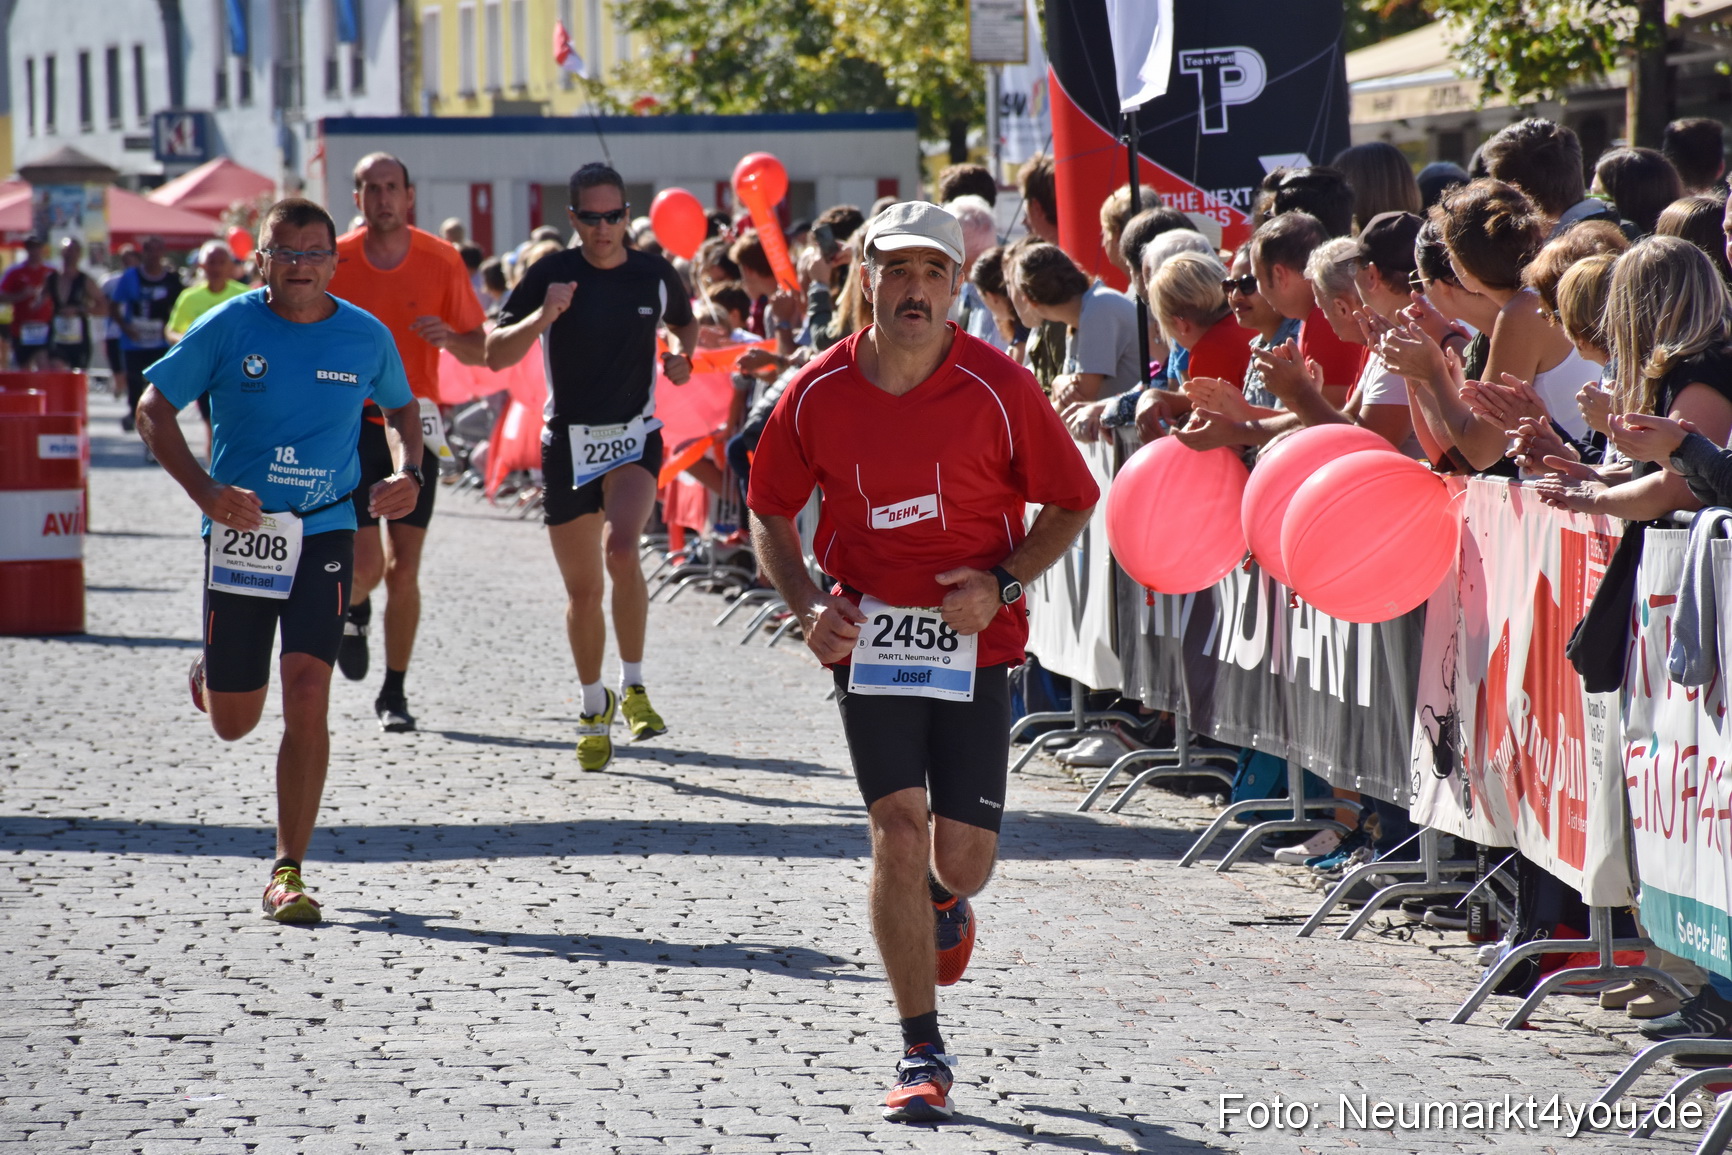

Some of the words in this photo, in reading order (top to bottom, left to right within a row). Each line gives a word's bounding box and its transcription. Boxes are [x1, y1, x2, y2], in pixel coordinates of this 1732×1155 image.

[1161, 191, 1199, 212] THE
[1203, 187, 1253, 209] NEXT
[316, 370, 358, 384] BOCK
[274, 446, 299, 465] 18.
[269, 462, 327, 477] Neumarkter
[267, 473, 317, 489] Stadtlauf
[888, 504, 919, 522] DEHN
[222, 528, 288, 562] 2308
[226, 559, 246, 567] PARTL
[246, 562, 274, 571] Neumarkt
[230, 571, 275, 588] Michael
[871, 613, 959, 652] 2458
[878, 653, 904, 661] PARTL
[904, 653, 940, 663] Neumarkt
[892, 668, 933, 684] Josef
